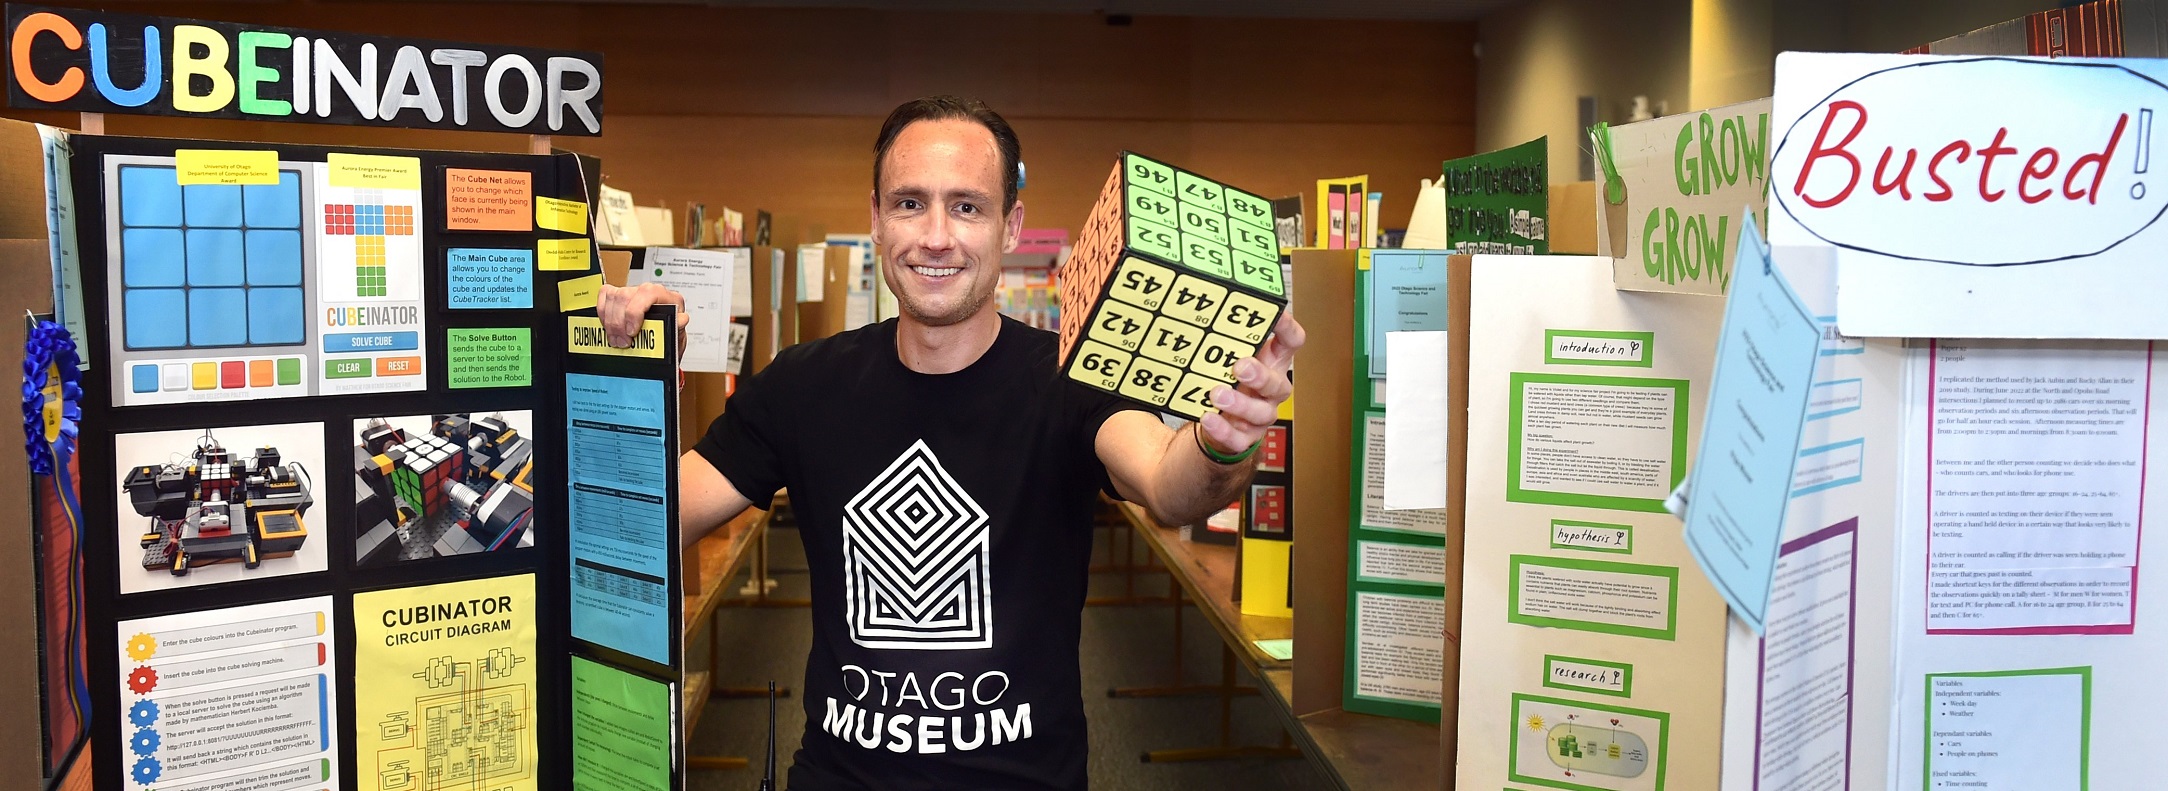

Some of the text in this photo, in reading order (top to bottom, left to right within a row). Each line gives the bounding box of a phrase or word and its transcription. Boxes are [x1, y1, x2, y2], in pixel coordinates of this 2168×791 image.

[11, 13, 600, 133] CUBEINATOR
[451, 174, 525, 185] The Cube Net allows
[1134, 164, 1168, 184] 46
[475, 186, 501, 195] change
[1185, 183, 1217, 200] 47
[477, 197, 507, 205] currently
[509, 197, 528, 207] being
[1136, 196, 1170, 215] 49
[1232, 198, 1266, 217] 48
[1187, 212, 1220, 233] 50
[1137, 226, 1172, 249] 52
[1237, 228, 1270, 250] 51
[488, 254, 507, 262] Cube
[1190, 244, 1223, 266] 53
[452, 264, 474, 272] allows
[499, 265, 525, 274] change
[1240, 260, 1274, 282] 54
[452, 274, 463, 282] the
[1122, 270, 1163, 295] 45
[486, 285, 514, 293] updates
[1144, 299, 1158, 308] D9
[1176, 288, 1214, 312] 44
[326, 306, 417, 326] CUBEINATOR
[1102, 312, 1141, 336] 42
[1195, 315, 1209, 324] D8
[1227, 305, 1266, 328] 43
[351, 336, 393, 347] SOLVE CUBE
[452, 334, 466, 342] The
[1122, 339, 1136, 348] D6
[1156, 329, 1192, 351] 41
[1246, 333, 1260, 342] D7
[452, 344, 474, 352] sends
[1204, 345, 1240, 368] 40
[1560, 342, 1624, 355] introduction
[337, 362, 359, 373] CLEAR
[388, 360, 409, 371] RESET
[1082, 353, 1121, 376] 39
[1174, 356, 1187, 365] D5
[453, 375, 480, 383] solution
[491, 374, 502, 382] the
[1101, 379, 1116, 388] D3
[1132, 369, 1172, 393] 38
[1151, 394, 1165, 403] D2
[1557, 528, 1610, 544] hypothesis
[382, 596, 513, 627] CUBINATOR
[245, 627, 273, 635] Cubeinator
[274, 624, 298, 632] program.
[385, 619, 512, 647] CIRCUIT DIAGRAM
[1554, 666, 1606, 683] research
[842, 664, 1010, 710] OTAGO
[822, 697, 1032, 754] MUSEUM
